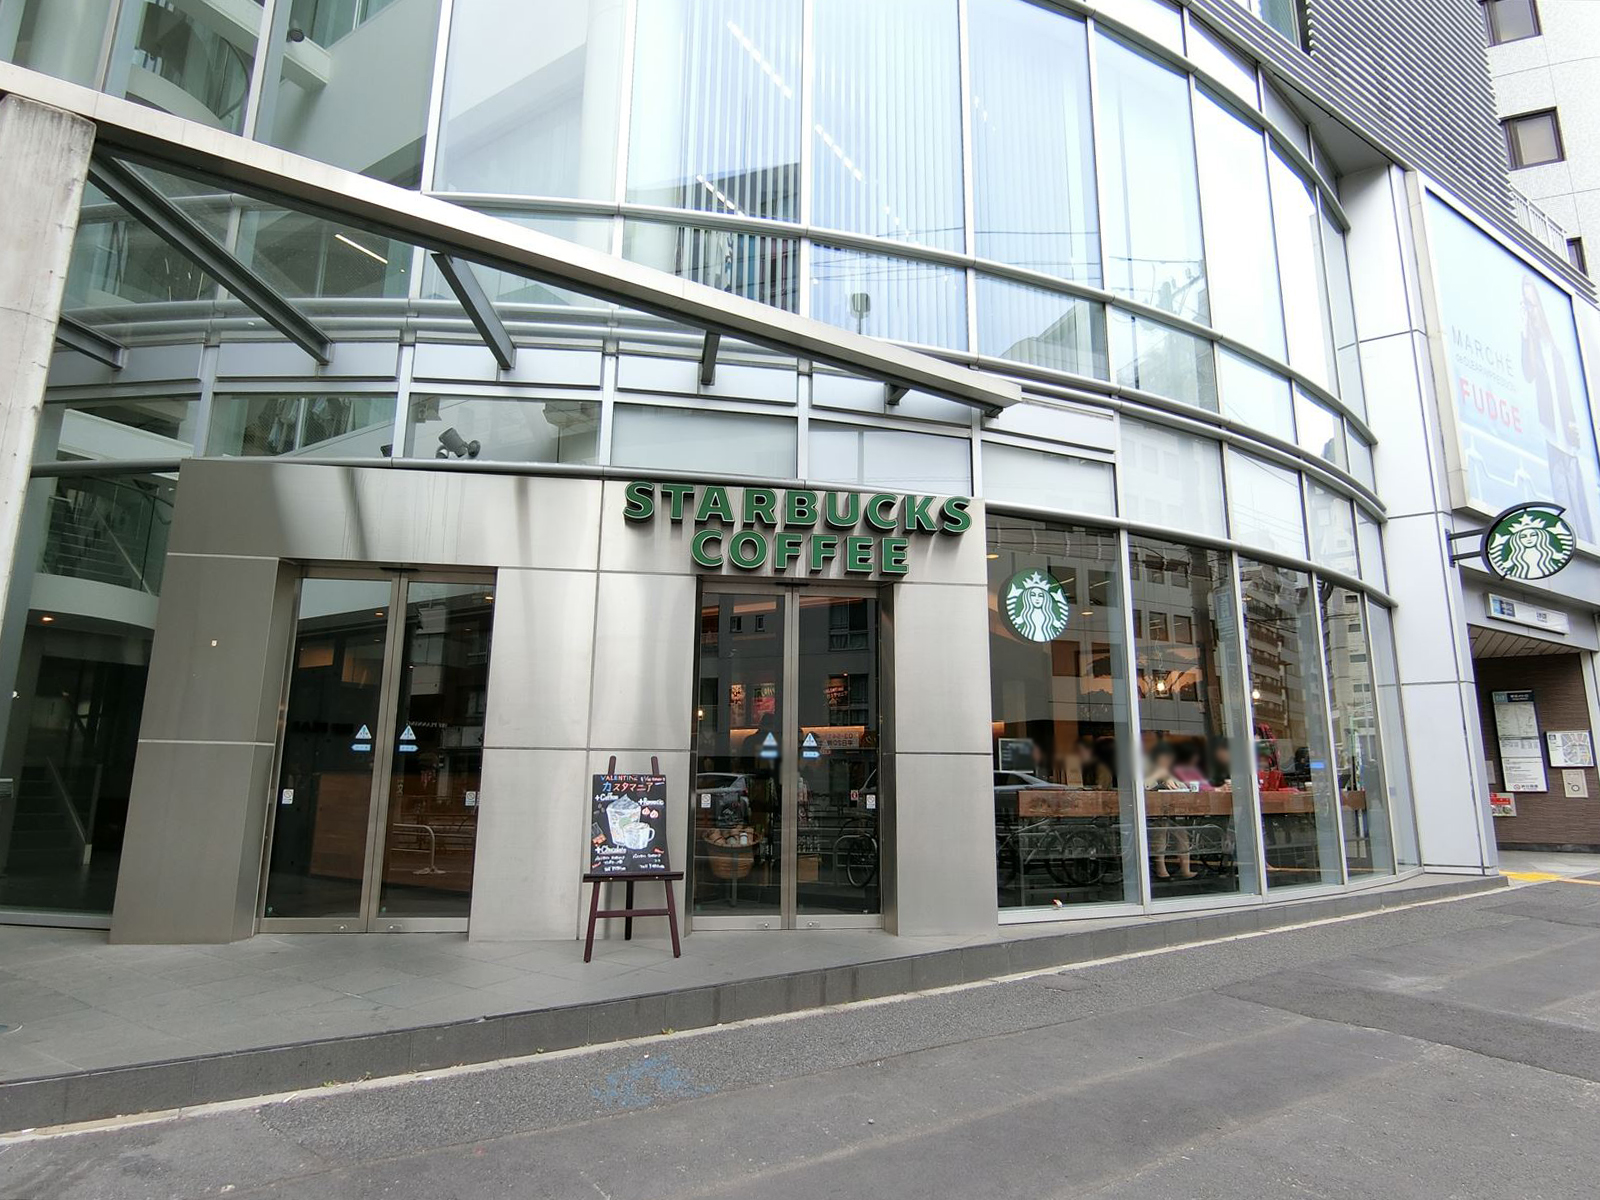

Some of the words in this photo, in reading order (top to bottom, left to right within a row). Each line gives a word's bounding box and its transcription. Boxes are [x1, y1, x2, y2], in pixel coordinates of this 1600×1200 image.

[1459, 377, 1523, 433] FUDGE
[623, 480, 973, 534] STARBUCKS
[690, 528, 910, 576] COFFEE
[602, 782, 653, 793] カスタマニア
